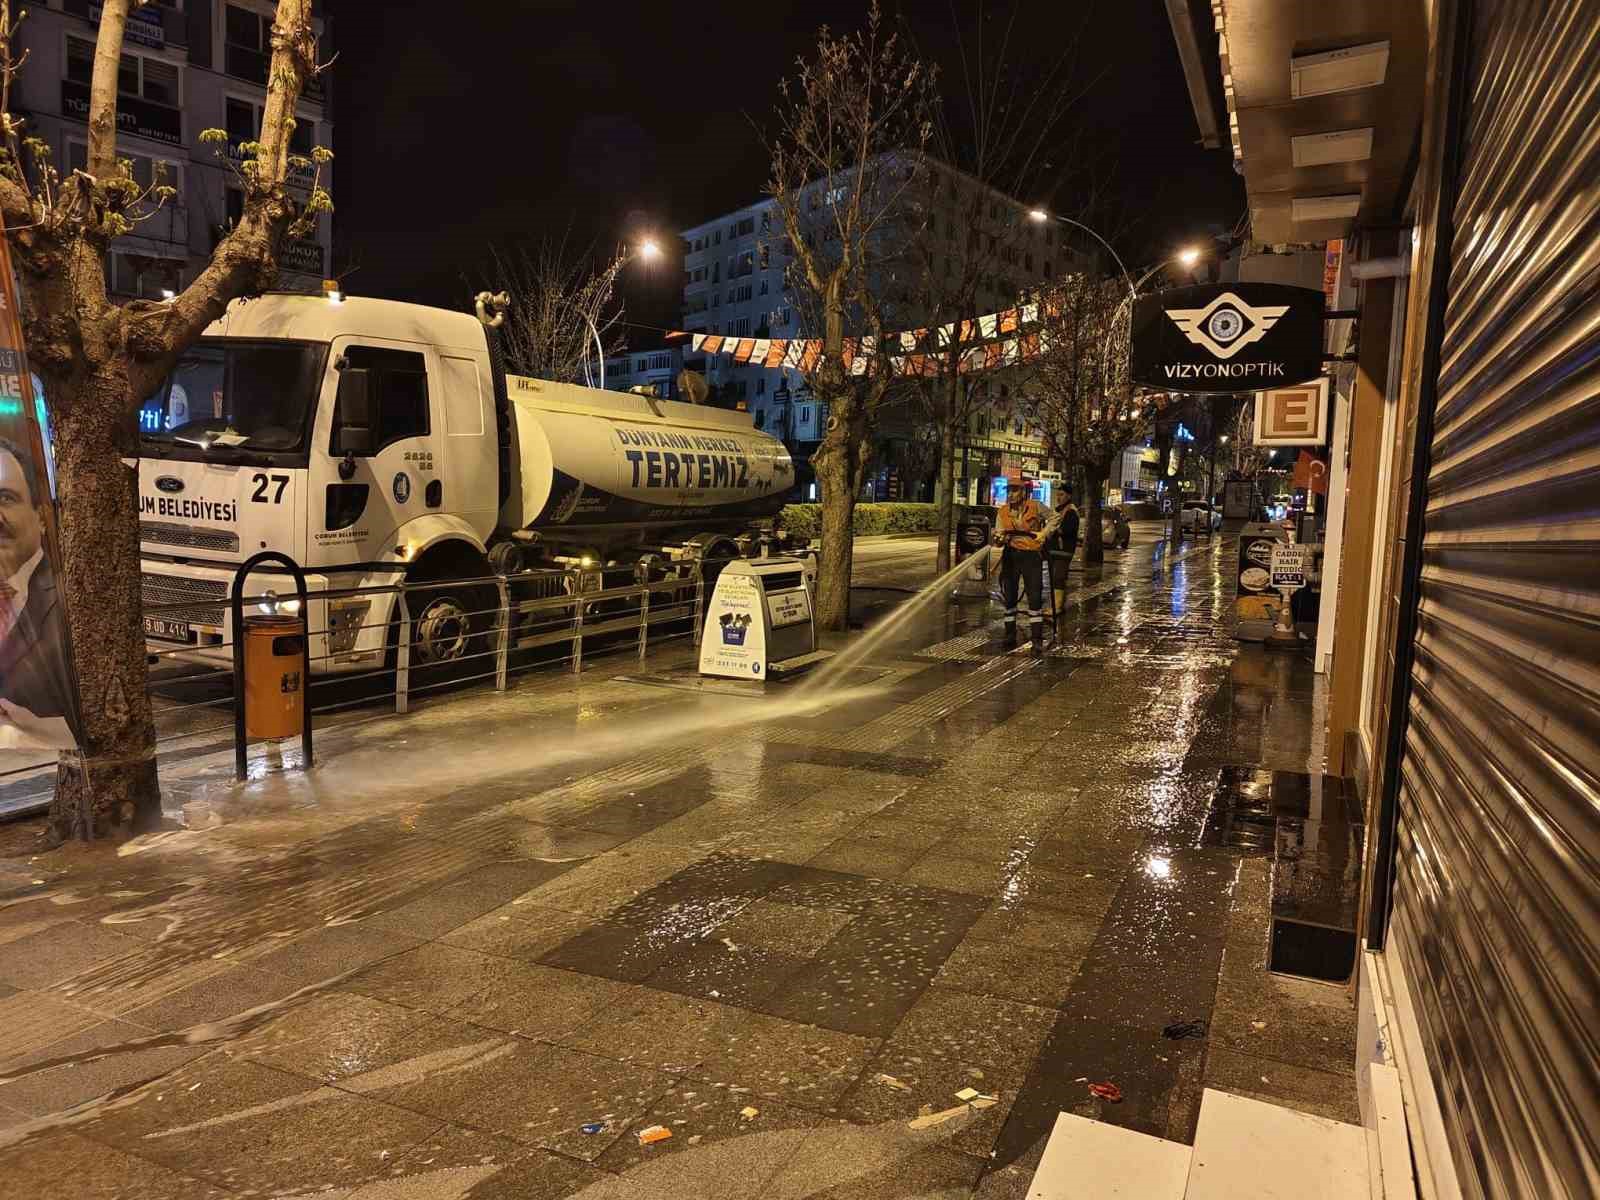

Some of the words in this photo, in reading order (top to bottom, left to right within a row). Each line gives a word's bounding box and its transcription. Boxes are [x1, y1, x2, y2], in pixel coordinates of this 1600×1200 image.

[1164, 361, 1285, 378] VİZYONOPTİK
[1273, 393, 1309, 432] E
[625, 450, 749, 489] TERTEMİZ
[251, 473, 290, 504] 27
[158, 496, 237, 522] BELEDİYESİ
